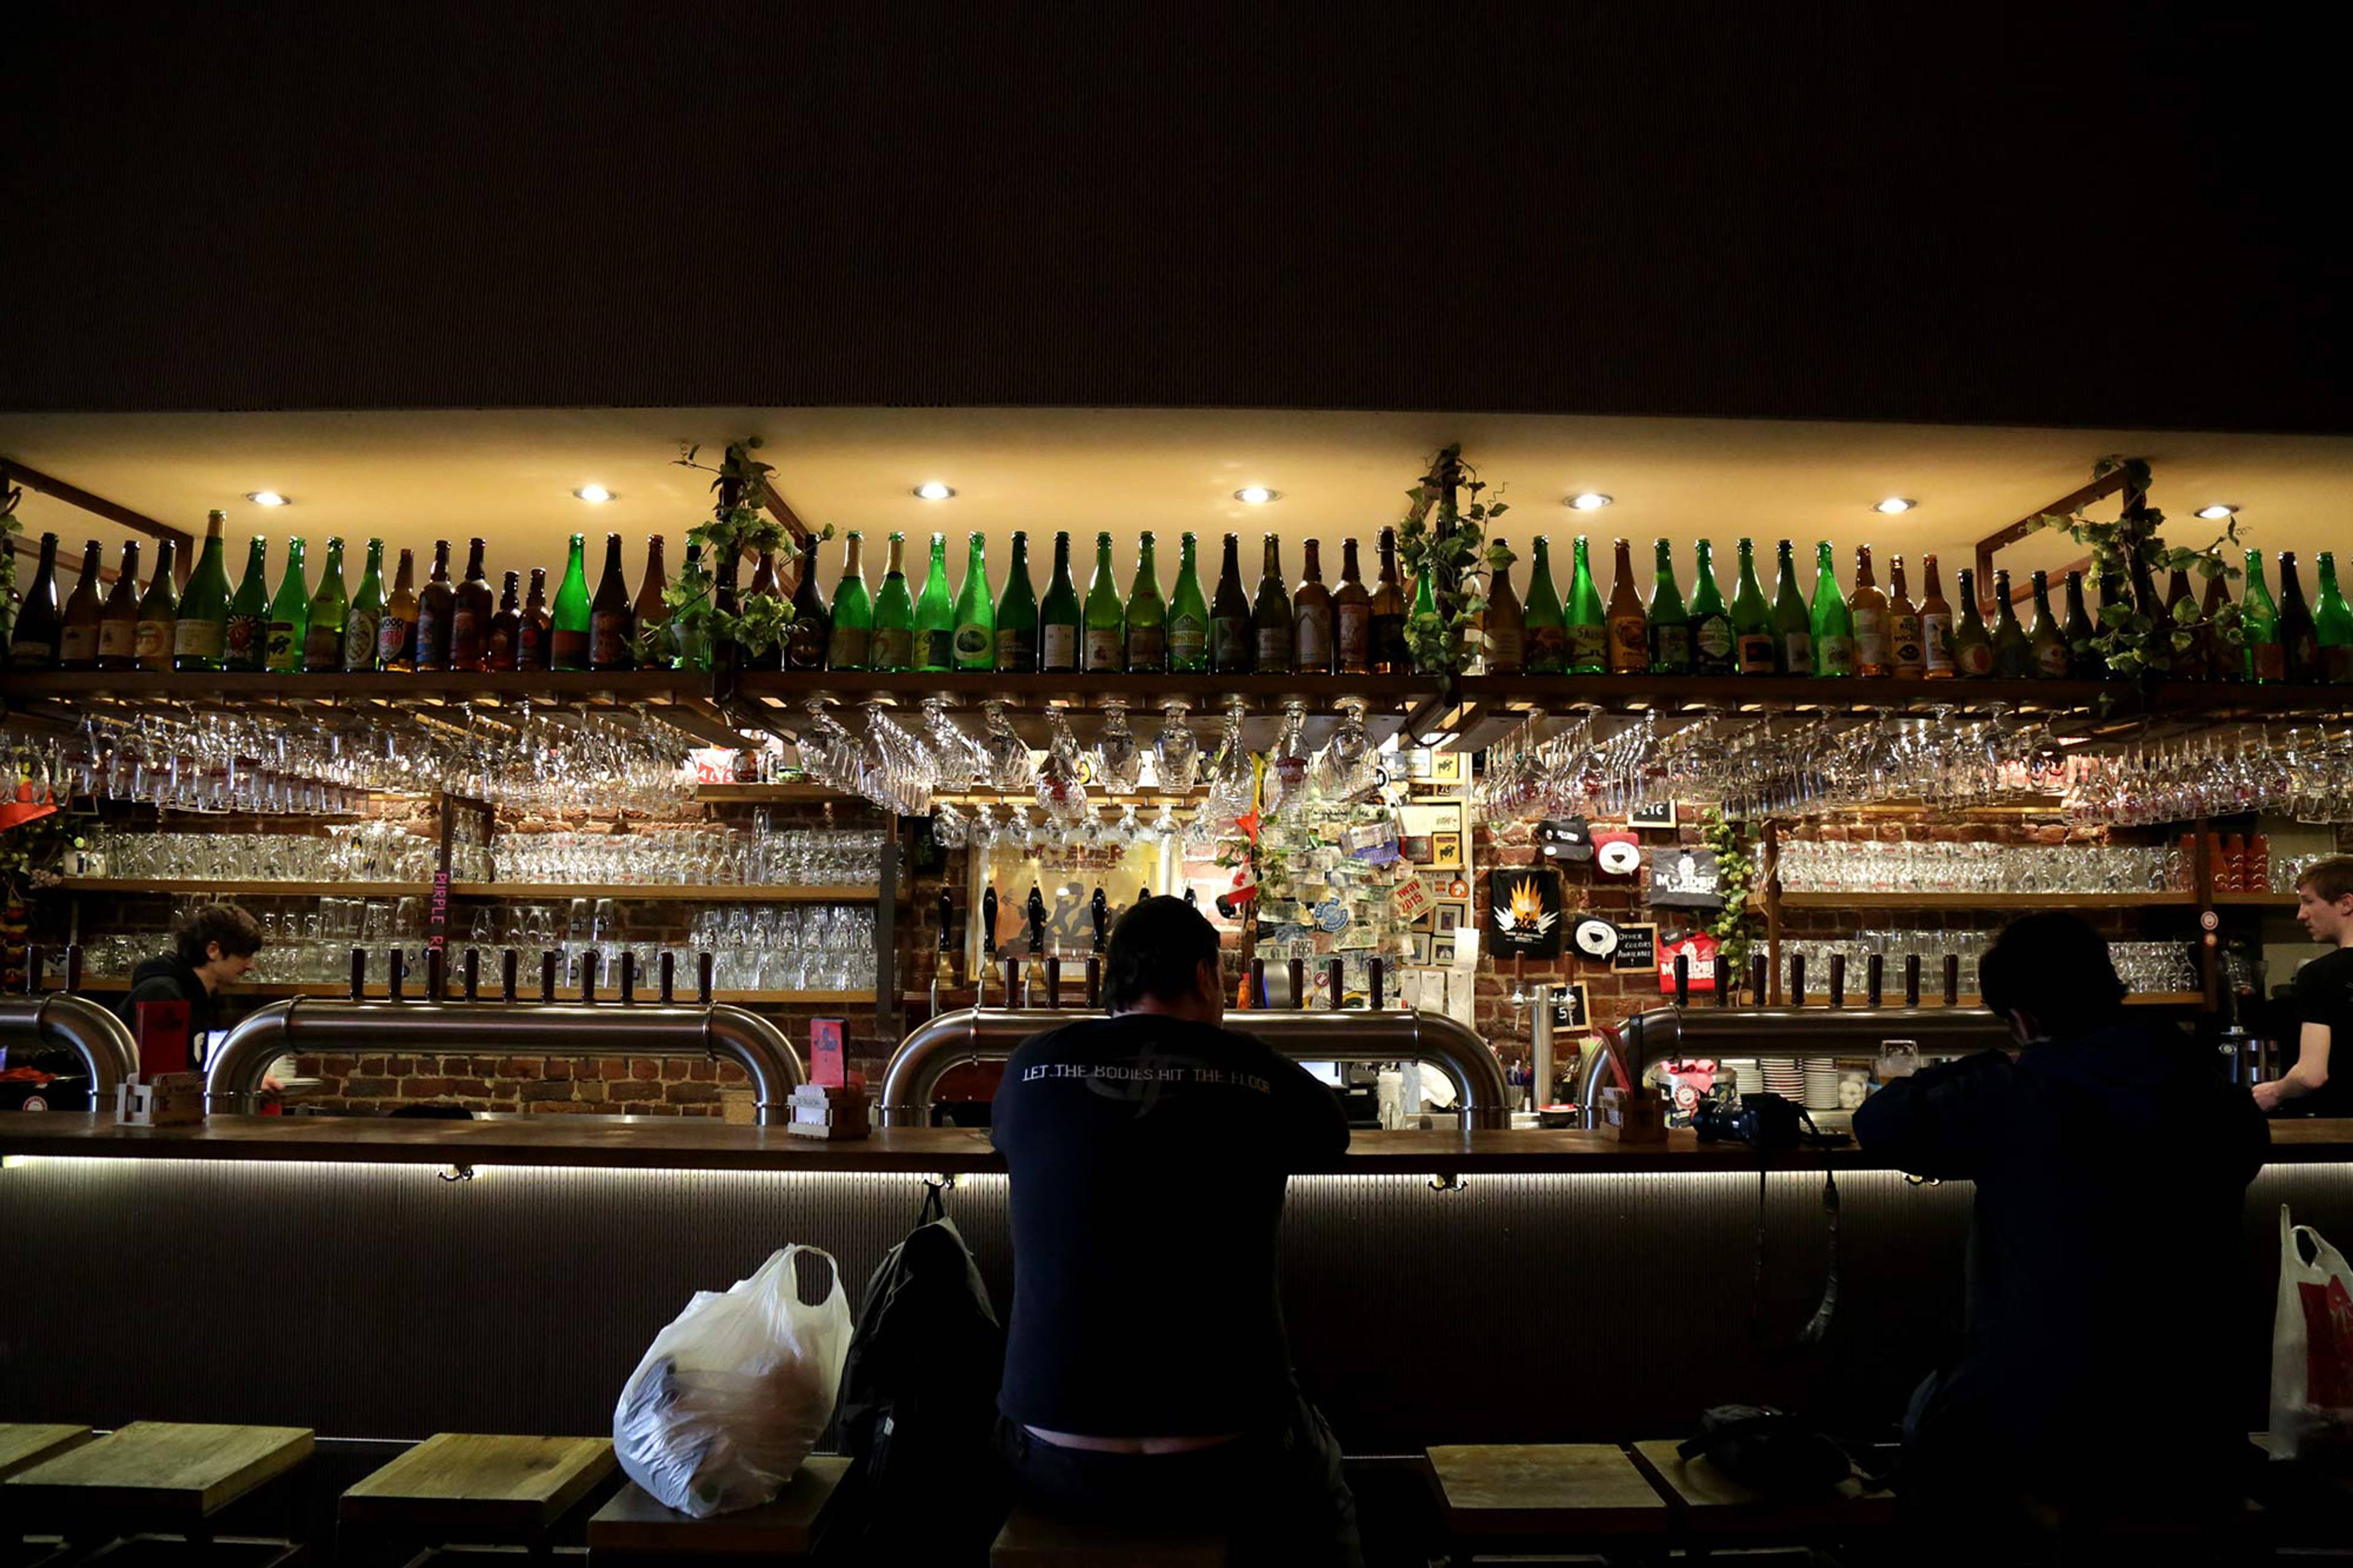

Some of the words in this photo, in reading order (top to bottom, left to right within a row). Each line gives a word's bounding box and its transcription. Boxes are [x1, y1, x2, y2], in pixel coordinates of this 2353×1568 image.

[431, 873, 447, 923] PURPLE
[1402, 893, 1423, 914] 2015
[1021, 1064, 1048, 1082] LET
[1055, 1064, 1088, 1078] THE
[1094, 1065, 1153, 1080] BODIES
[1158, 1068, 1185, 1081] HIT
[1192, 1069, 1226, 1083] THE
[1230, 1072, 1272, 1096] FLOOR
